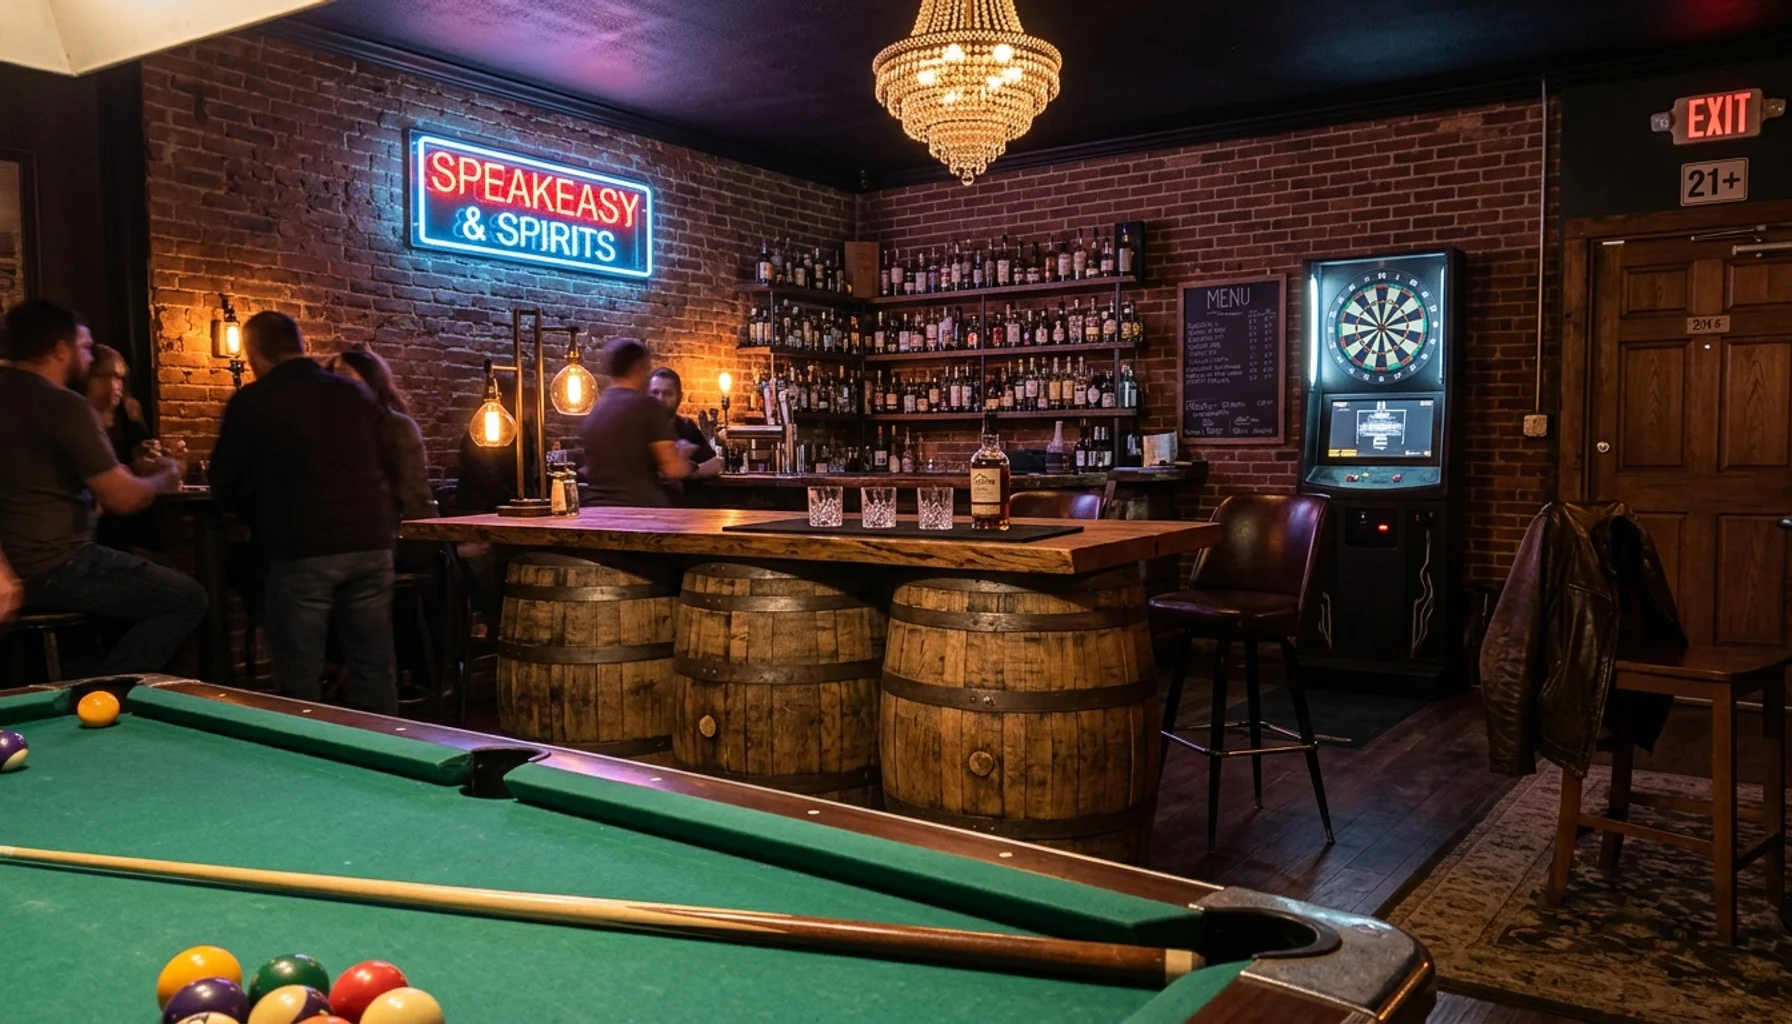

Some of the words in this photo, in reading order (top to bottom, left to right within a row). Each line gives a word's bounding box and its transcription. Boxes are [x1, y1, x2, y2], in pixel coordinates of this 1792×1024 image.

[1687, 92, 1752, 139] EXIT
[430, 151, 639, 228] SPEAKEASY
[1687, 167, 1741, 198] 21+
[462, 206, 486, 242] &
[496, 212, 616, 263] SPIRITS
[1206, 287, 1251, 310] MENU
